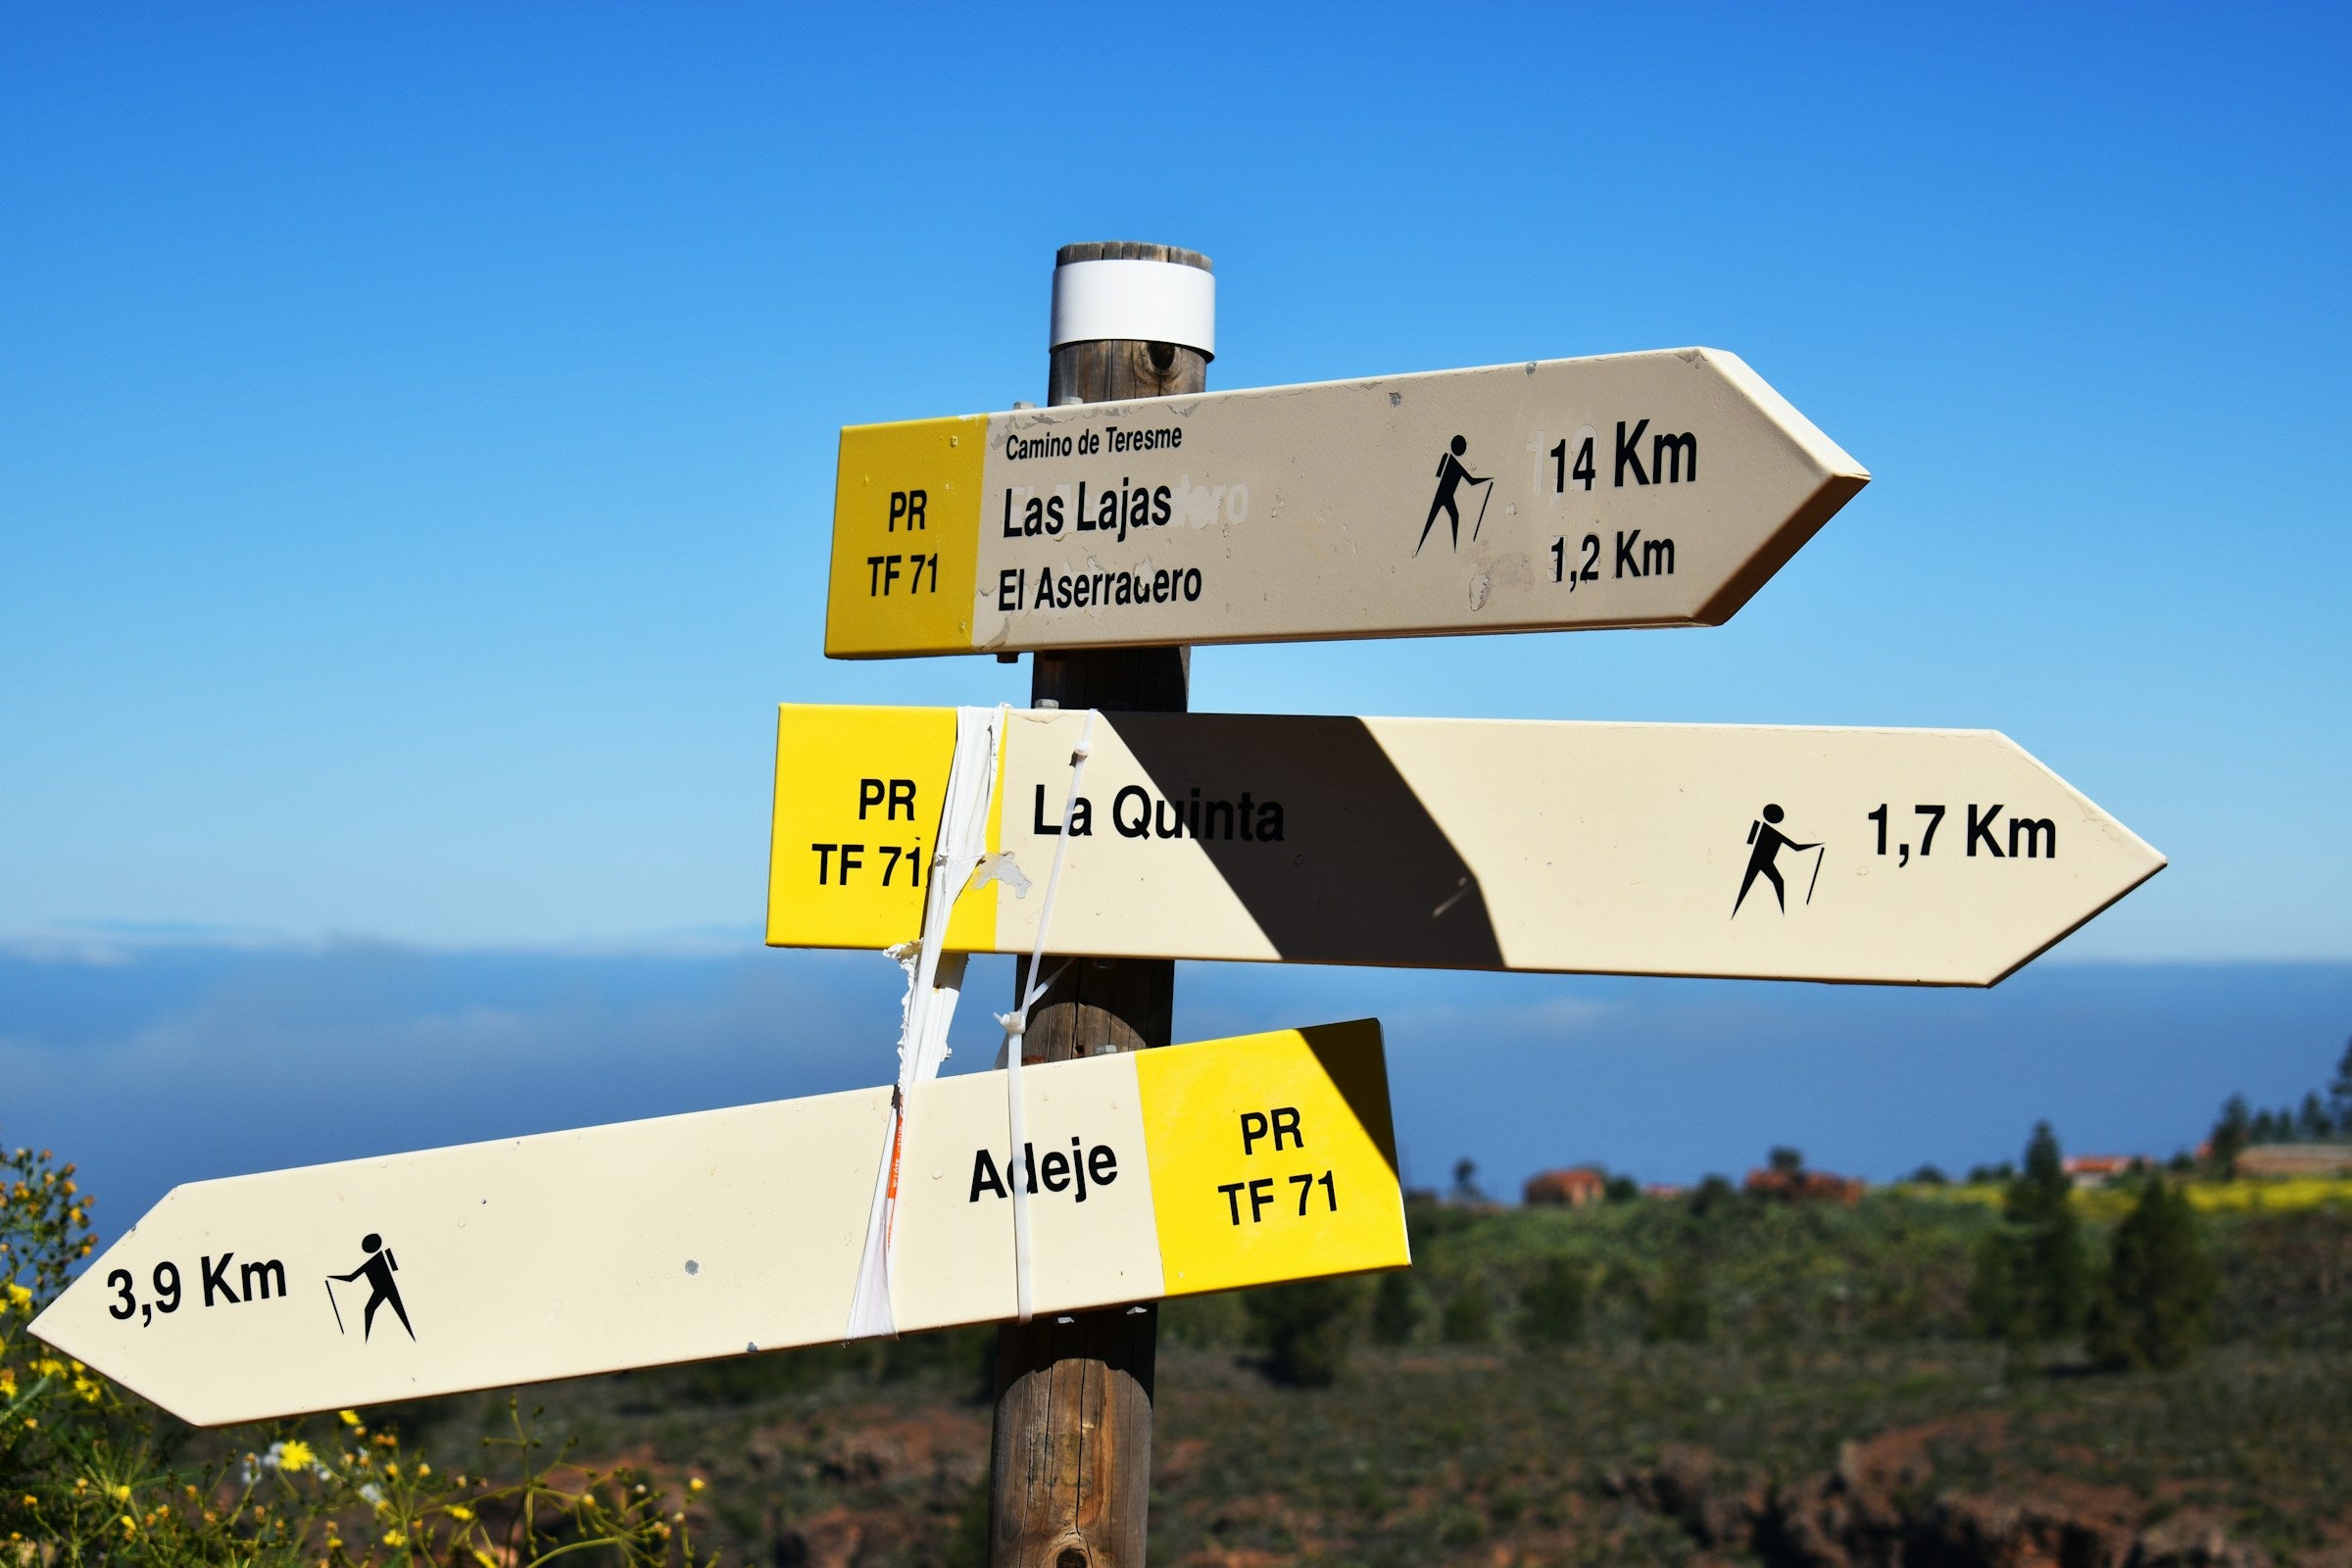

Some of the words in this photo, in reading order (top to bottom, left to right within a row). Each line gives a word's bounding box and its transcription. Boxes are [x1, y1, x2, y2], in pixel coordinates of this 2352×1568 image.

[1005, 434, 1073, 461] Camino
[1077, 428, 1100, 456] de
[1105, 425, 1183, 453] Teresme
[1550, 436, 1596, 494] 14
[1614, 418, 1697, 487] Km
[888, 489, 928, 533] PR
[1003, 488, 1064, 538] Las
[1076, 476, 1172, 542] Lajas
[866, 554, 903, 597] TF
[909, 553, 938, 595] 71
[1550, 533, 1600, 593] 1,2
[1615, 528, 1675, 579] Km
[998, 568, 1025, 612] El
[858, 778, 916, 821] PR
[1034, 784, 1093, 837] La
[1112, 784, 1285, 843] Quinta
[1868, 803, 1945, 868] 1,7
[1966, 804, 2056, 858] Km
[811, 843, 864, 886] TF
[879, 846, 920, 887] 71
[1240, 1106, 1304, 1155] PR
[969, 1136, 1118, 1203] Adeje
[1217, 1178, 1274, 1226] TF
[1289, 1170, 1338, 1216] 71
[107, 1261, 181, 1328] 3,9
[200, 1251, 287, 1307] Km
